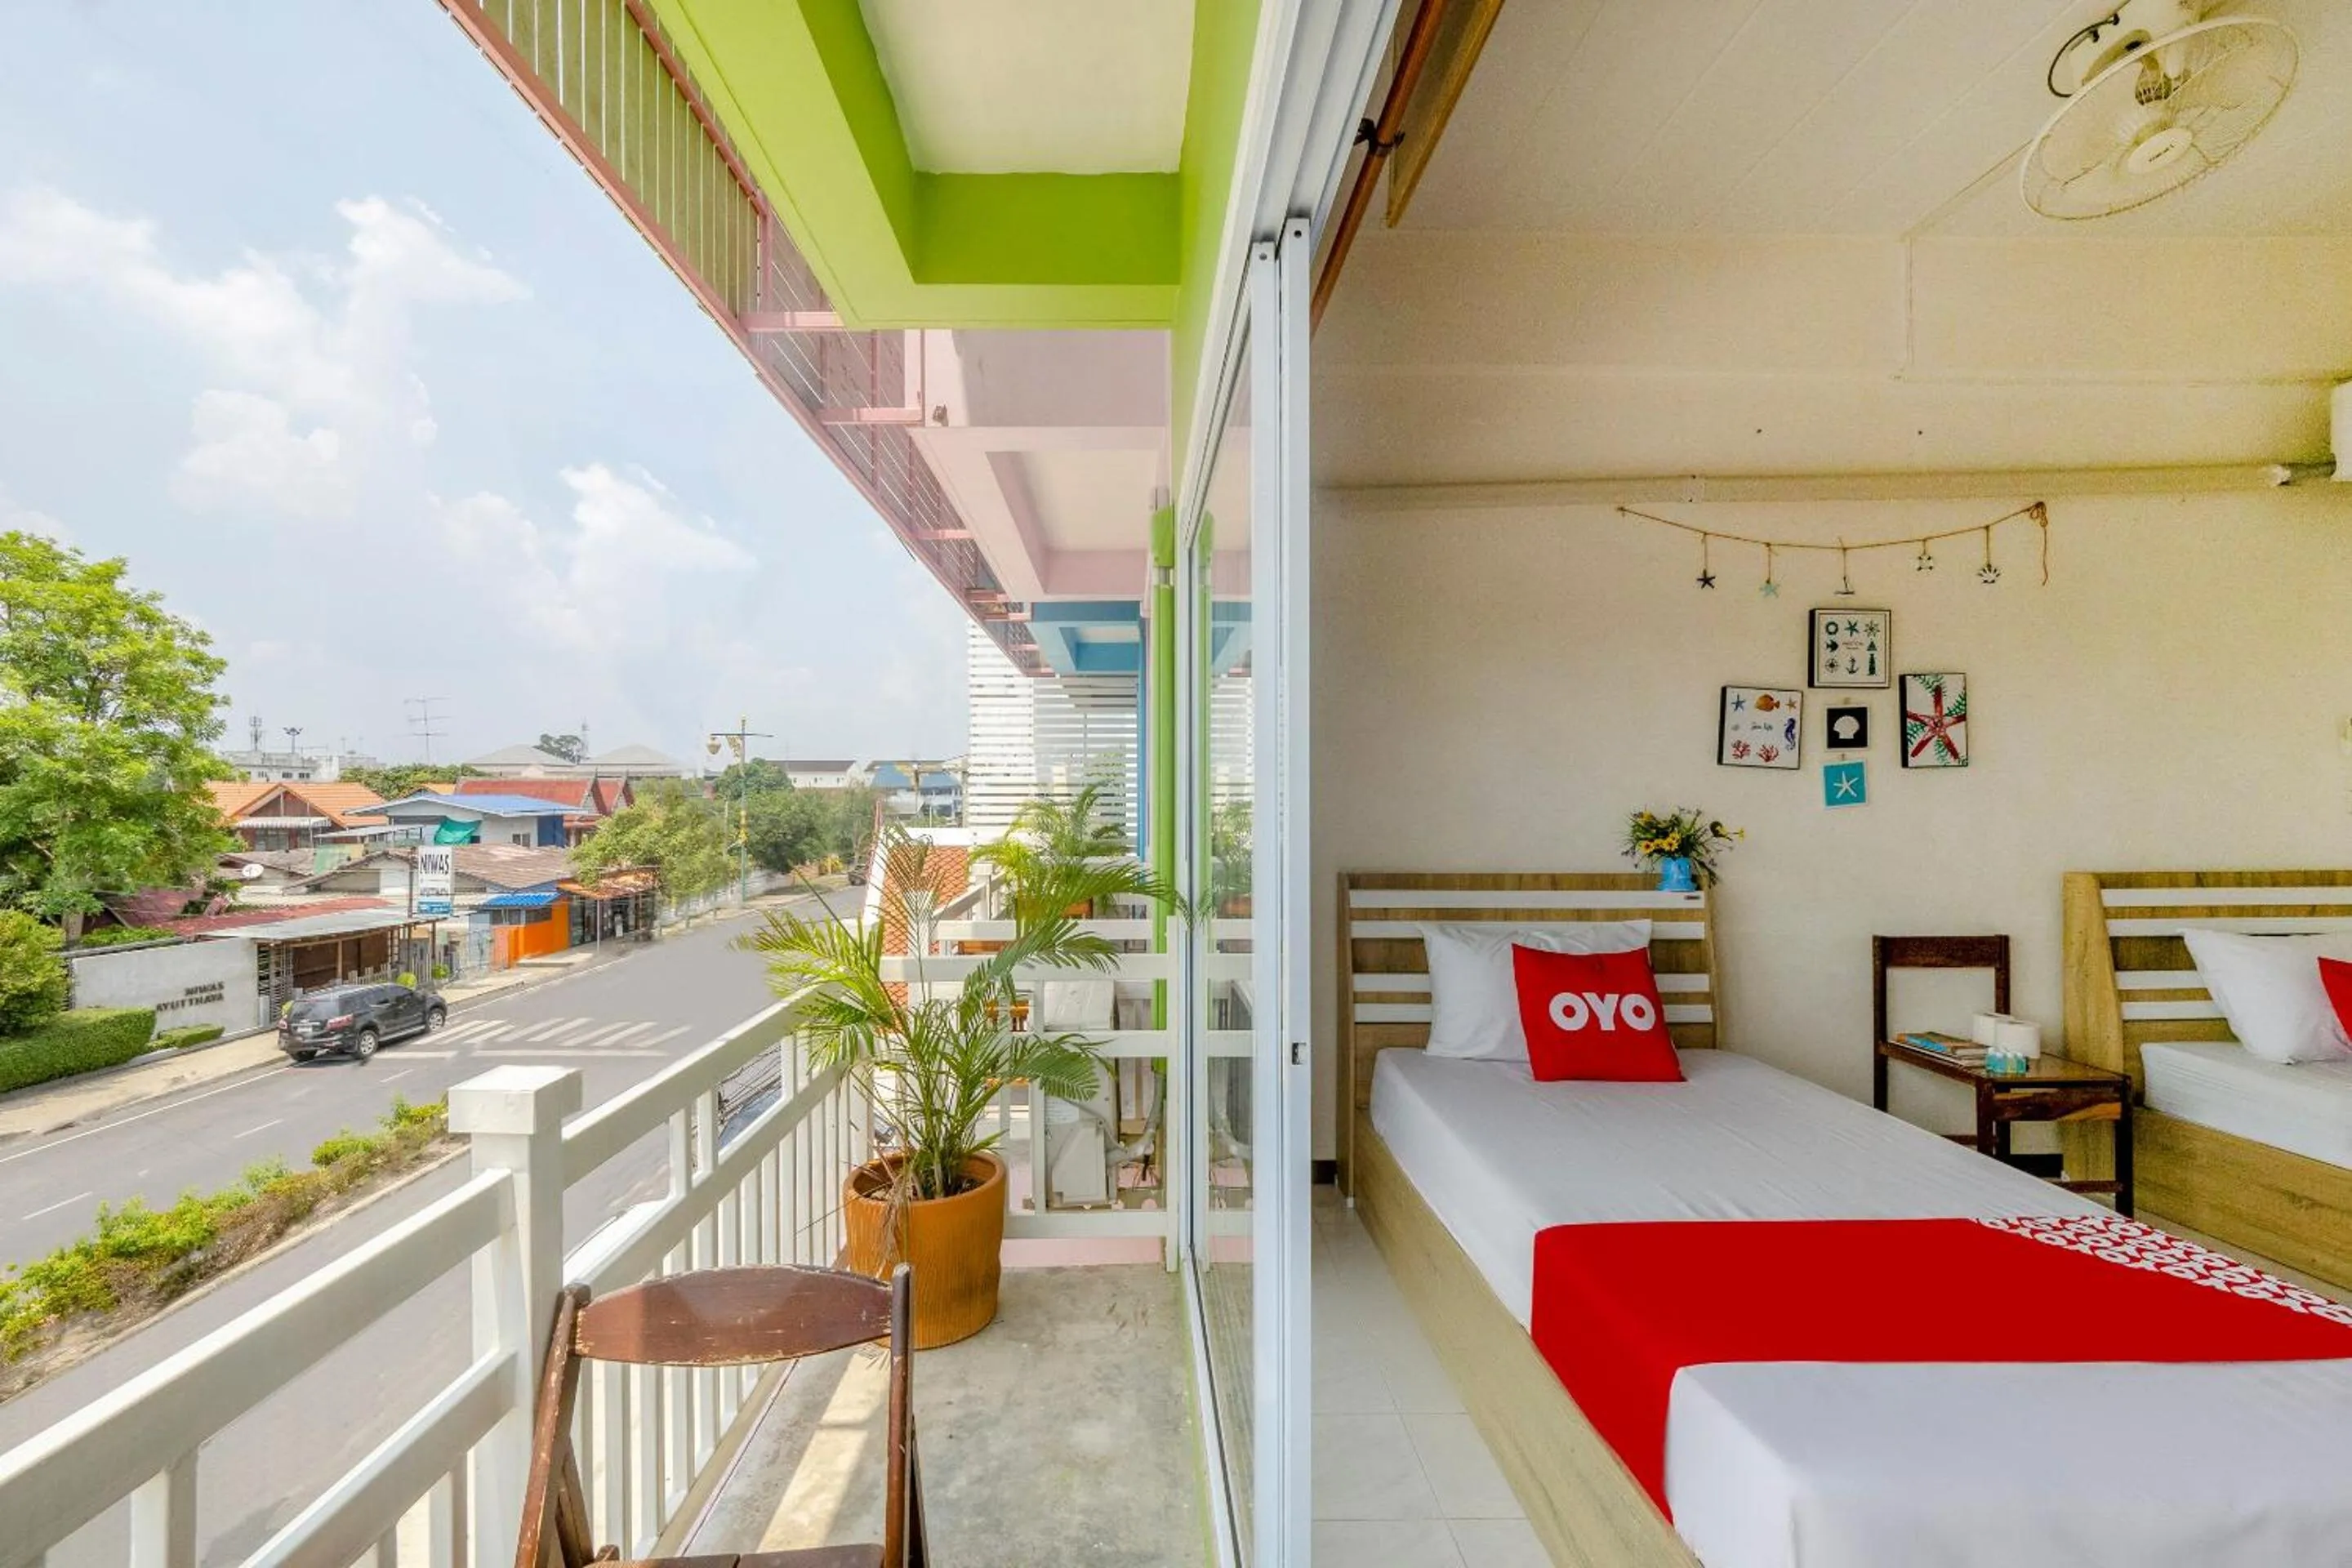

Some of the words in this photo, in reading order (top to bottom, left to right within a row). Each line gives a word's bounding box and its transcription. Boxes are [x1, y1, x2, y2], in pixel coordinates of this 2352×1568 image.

[420, 853, 449, 875] NIWAS
[185, 981, 225, 996] NIWAS
[156, 992, 225, 1012] AYUTTHAYA
[1548, 992, 1656, 1031] OYO
